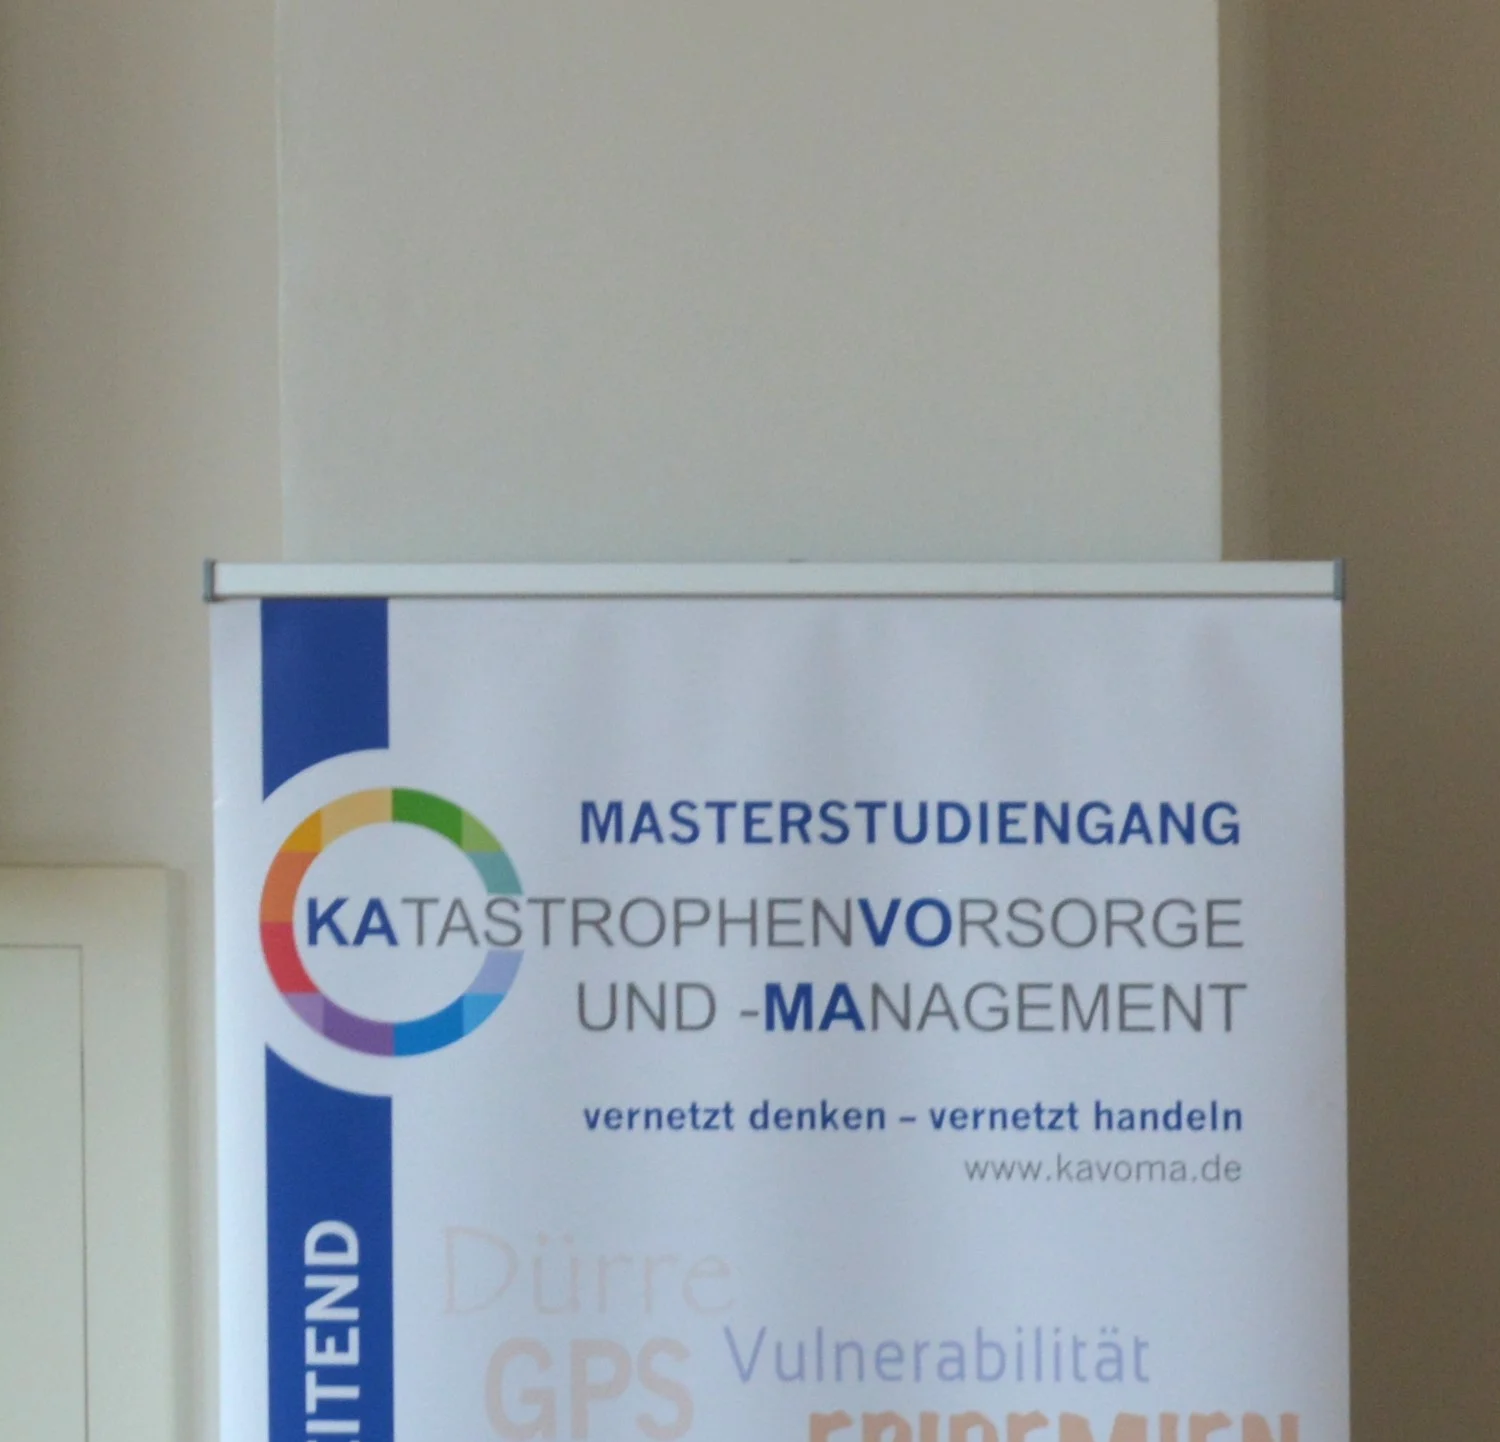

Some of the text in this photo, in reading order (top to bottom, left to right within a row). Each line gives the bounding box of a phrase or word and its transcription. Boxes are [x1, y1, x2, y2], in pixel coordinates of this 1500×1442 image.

[580, 801, 1241, 846] MASTERSTUDIENGANG
[307, 897, 1243, 948] KATASTROPHENVORSORGE
[578, 982, 1246, 1033] UND -MANAGEMENT
[584, 1101, 734, 1131] vernetzt
[749, 1098, 886, 1131] denken
[929, 1101, 1079, 1131] vernetzt
[1093, 1098, 1242, 1131] handeln
[964, 1153, 1242, 1182] www.kavoma.de
[441, 1227, 734, 1314] Dürre
[723, 1325, 1151, 1384] Vulnerabilität
[483, 1337, 693, 1442] GPS
